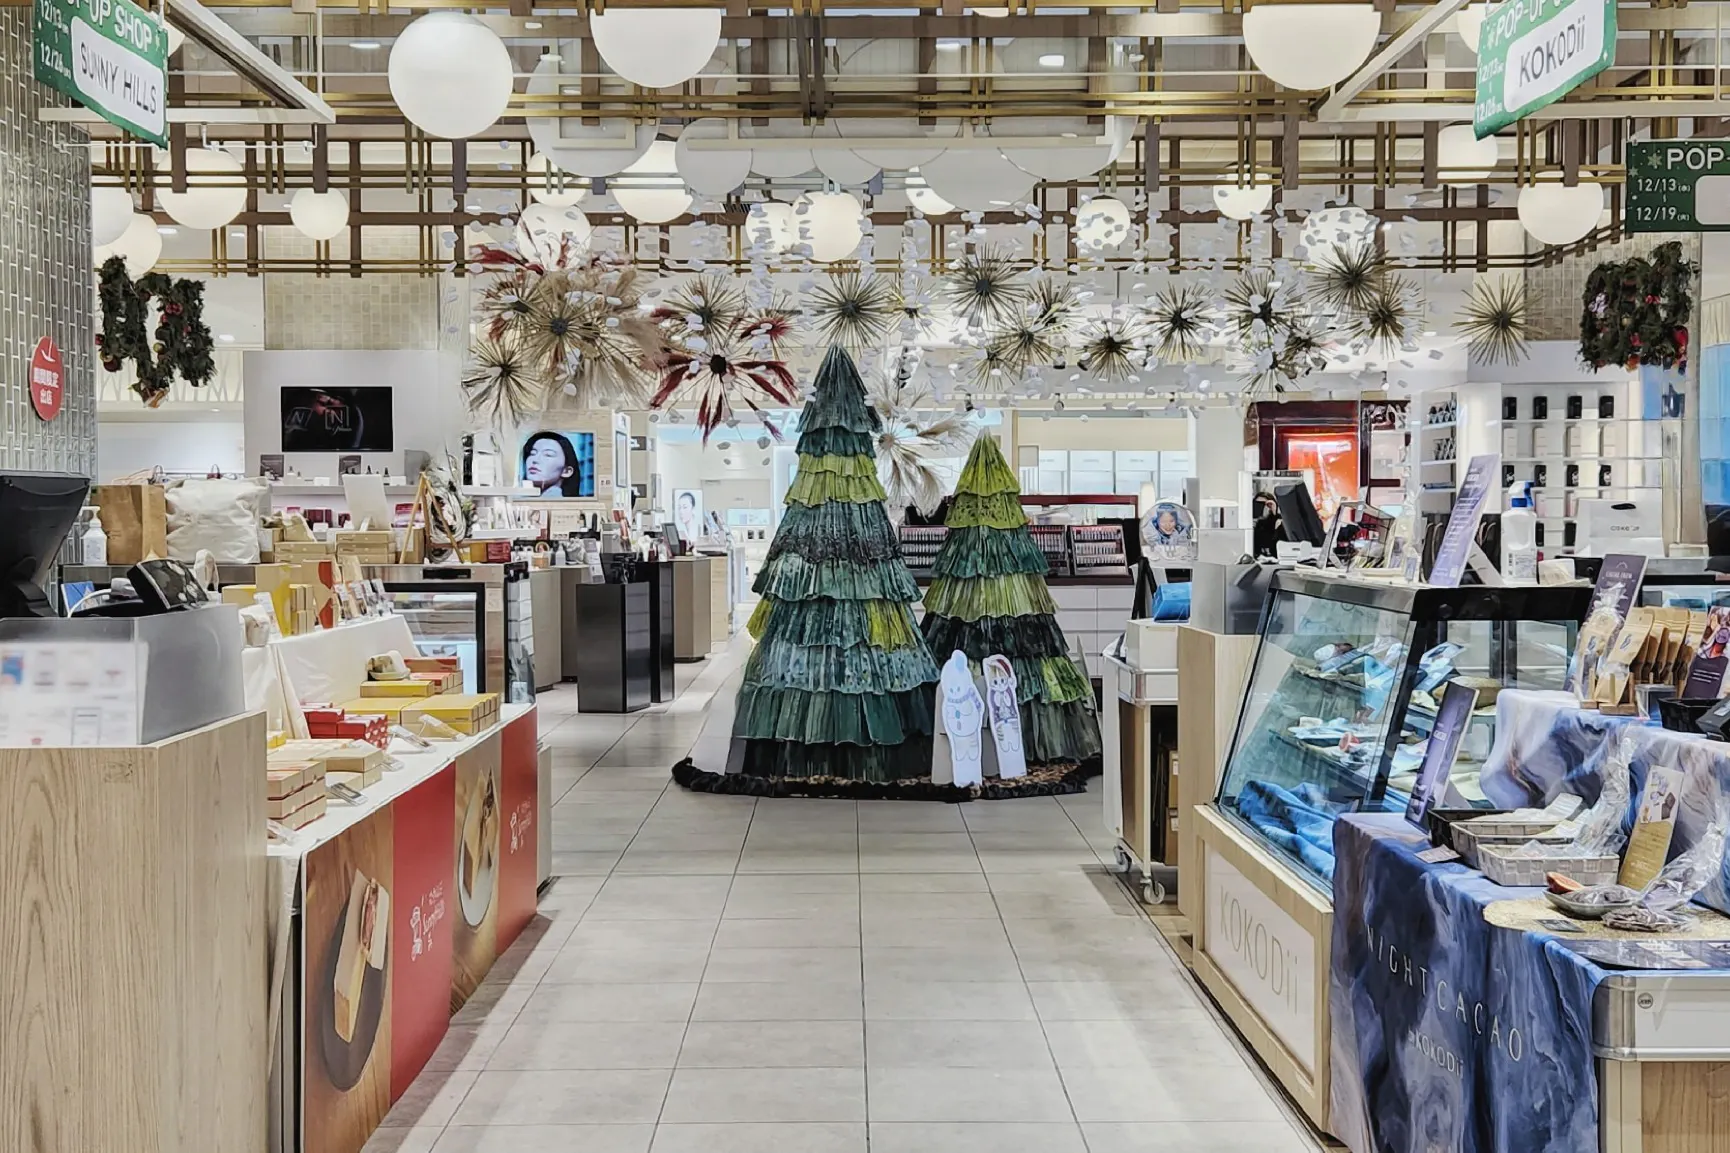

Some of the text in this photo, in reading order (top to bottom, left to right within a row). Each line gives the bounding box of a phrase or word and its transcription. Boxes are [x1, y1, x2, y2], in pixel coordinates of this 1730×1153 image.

[114, 5, 152, 53] SHOP
[80, 41, 157, 114] SUNNY HILLS
